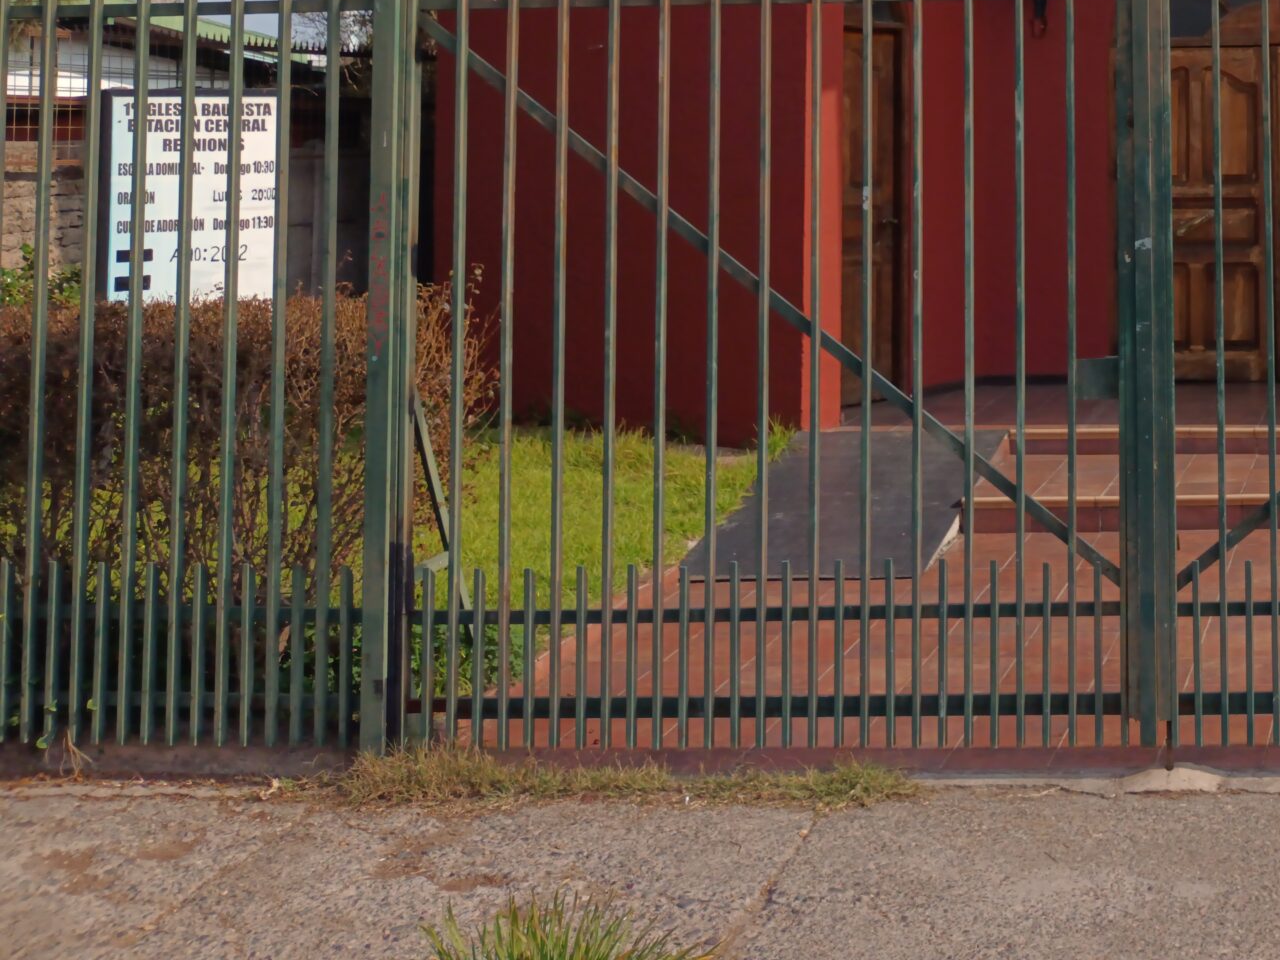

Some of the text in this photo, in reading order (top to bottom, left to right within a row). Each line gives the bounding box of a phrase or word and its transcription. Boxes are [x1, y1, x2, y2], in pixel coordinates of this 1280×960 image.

[143, 102, 198, 116] GLES
[201, 102, 272, 117] BAUISTA
[127, 118, 268, 133] ETACIN CENRAL
[162, 138, 245, 153] RENION
[117, 162, 154, 176] ESCLA
[214, 161, 251, 176] Dogo
[252, 160, 275, 174] 10:30
[117, 189, 155, 205] ORÓN
[212, 189, 243, 202] Lus
[156, 217, 205, 233] ADORÓN
[213, 217, 250, 231] Dogo
